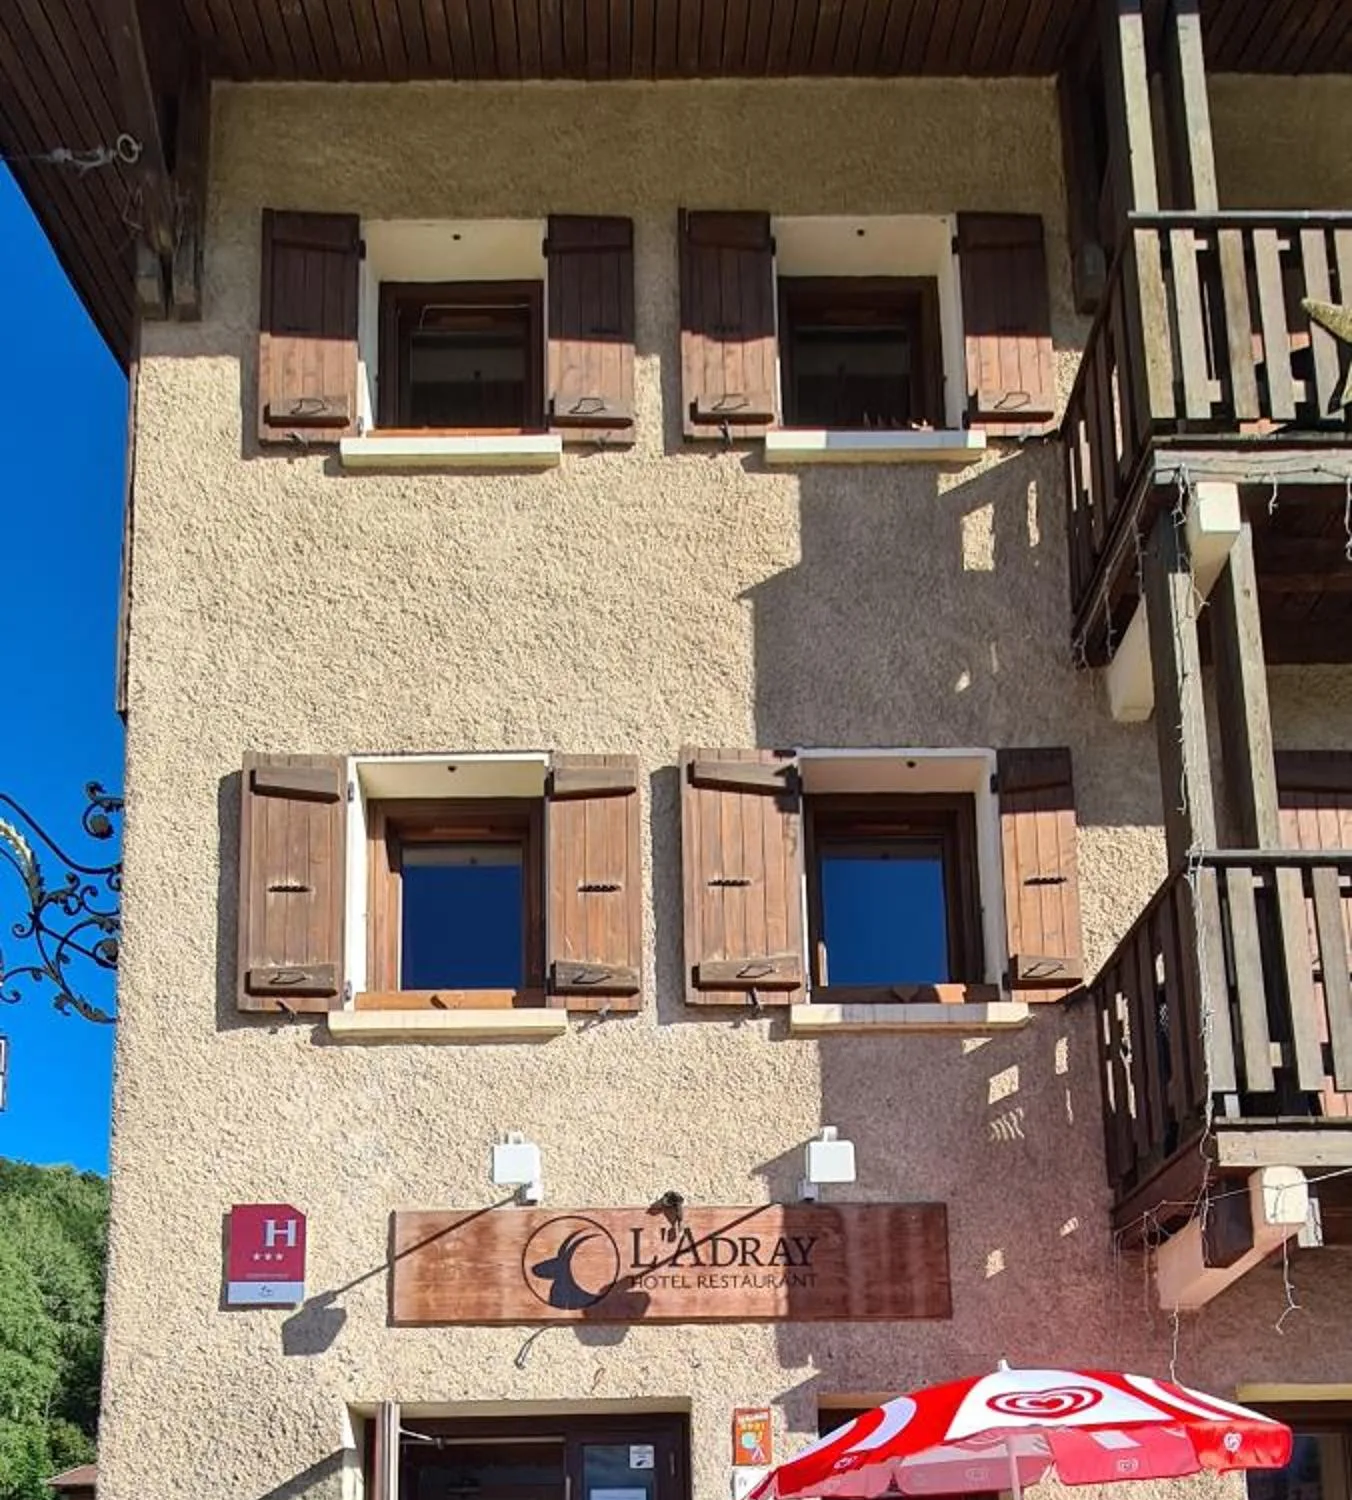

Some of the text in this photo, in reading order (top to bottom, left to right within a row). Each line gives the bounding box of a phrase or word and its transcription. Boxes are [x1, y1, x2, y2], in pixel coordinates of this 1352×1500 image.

[264, 1219, 297, 1247] H
[633, 1273, 818, 1289] HOTEL RESTAURANT
